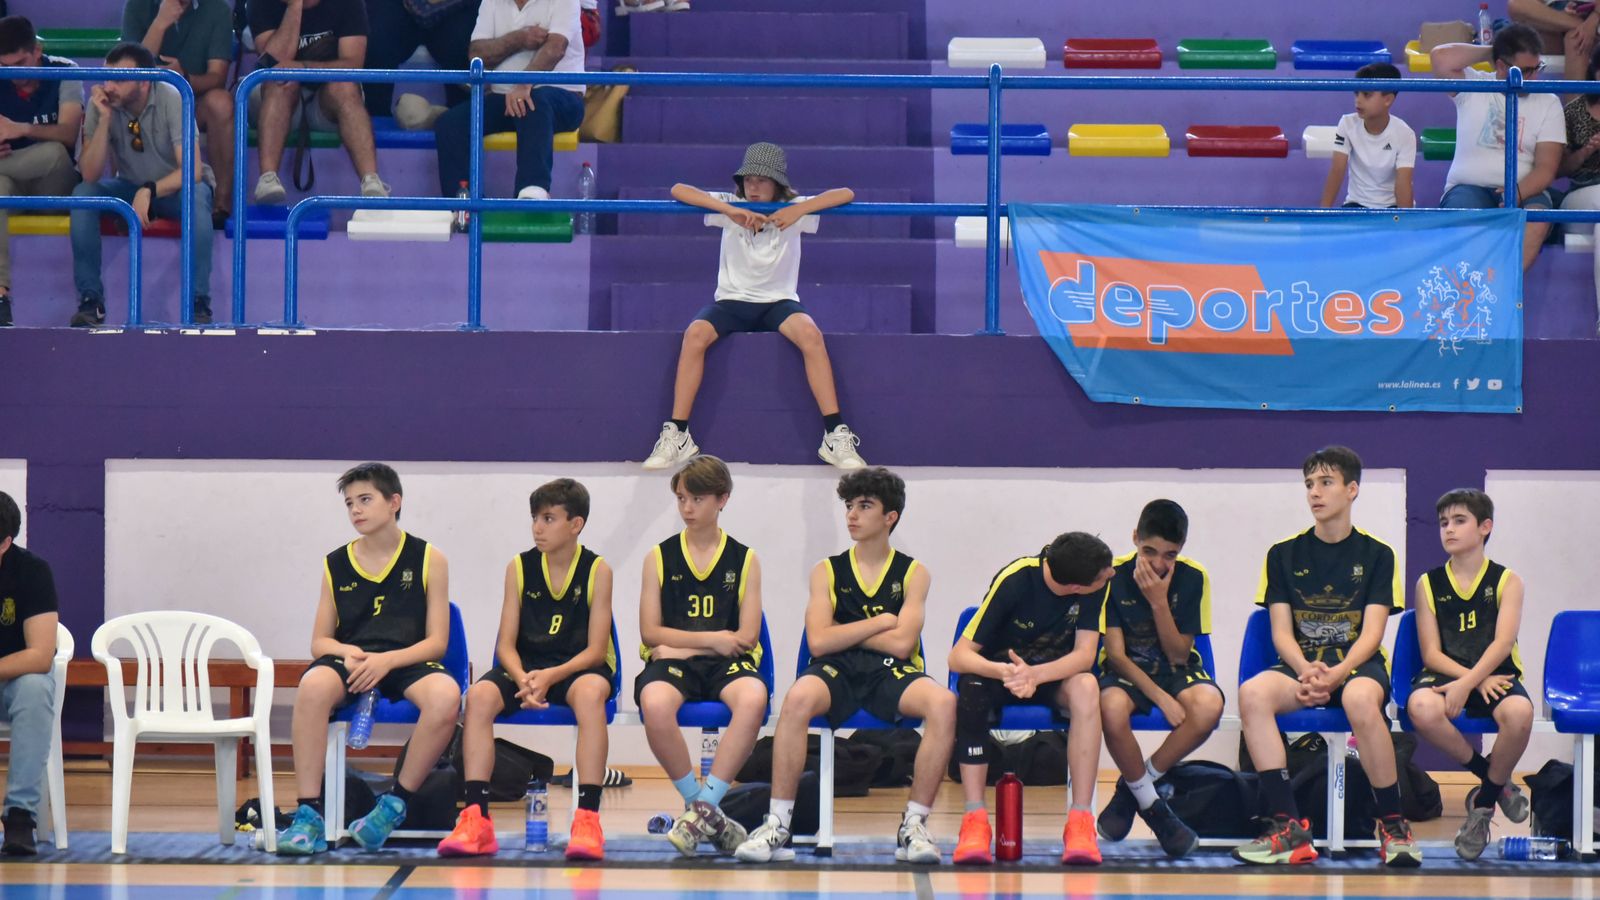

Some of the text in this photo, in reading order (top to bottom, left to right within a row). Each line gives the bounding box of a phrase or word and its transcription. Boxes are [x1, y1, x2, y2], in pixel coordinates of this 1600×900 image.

[1048, 259, 1405, 345] deportes
[1377, 379, 1441, 389] www.lalinea.es
[373, 595, 385, 616] 5
[688, 594, 714, 618] 30
[549, 614, 563, 635] 8
[1458, 609, 1477, 632] 19
